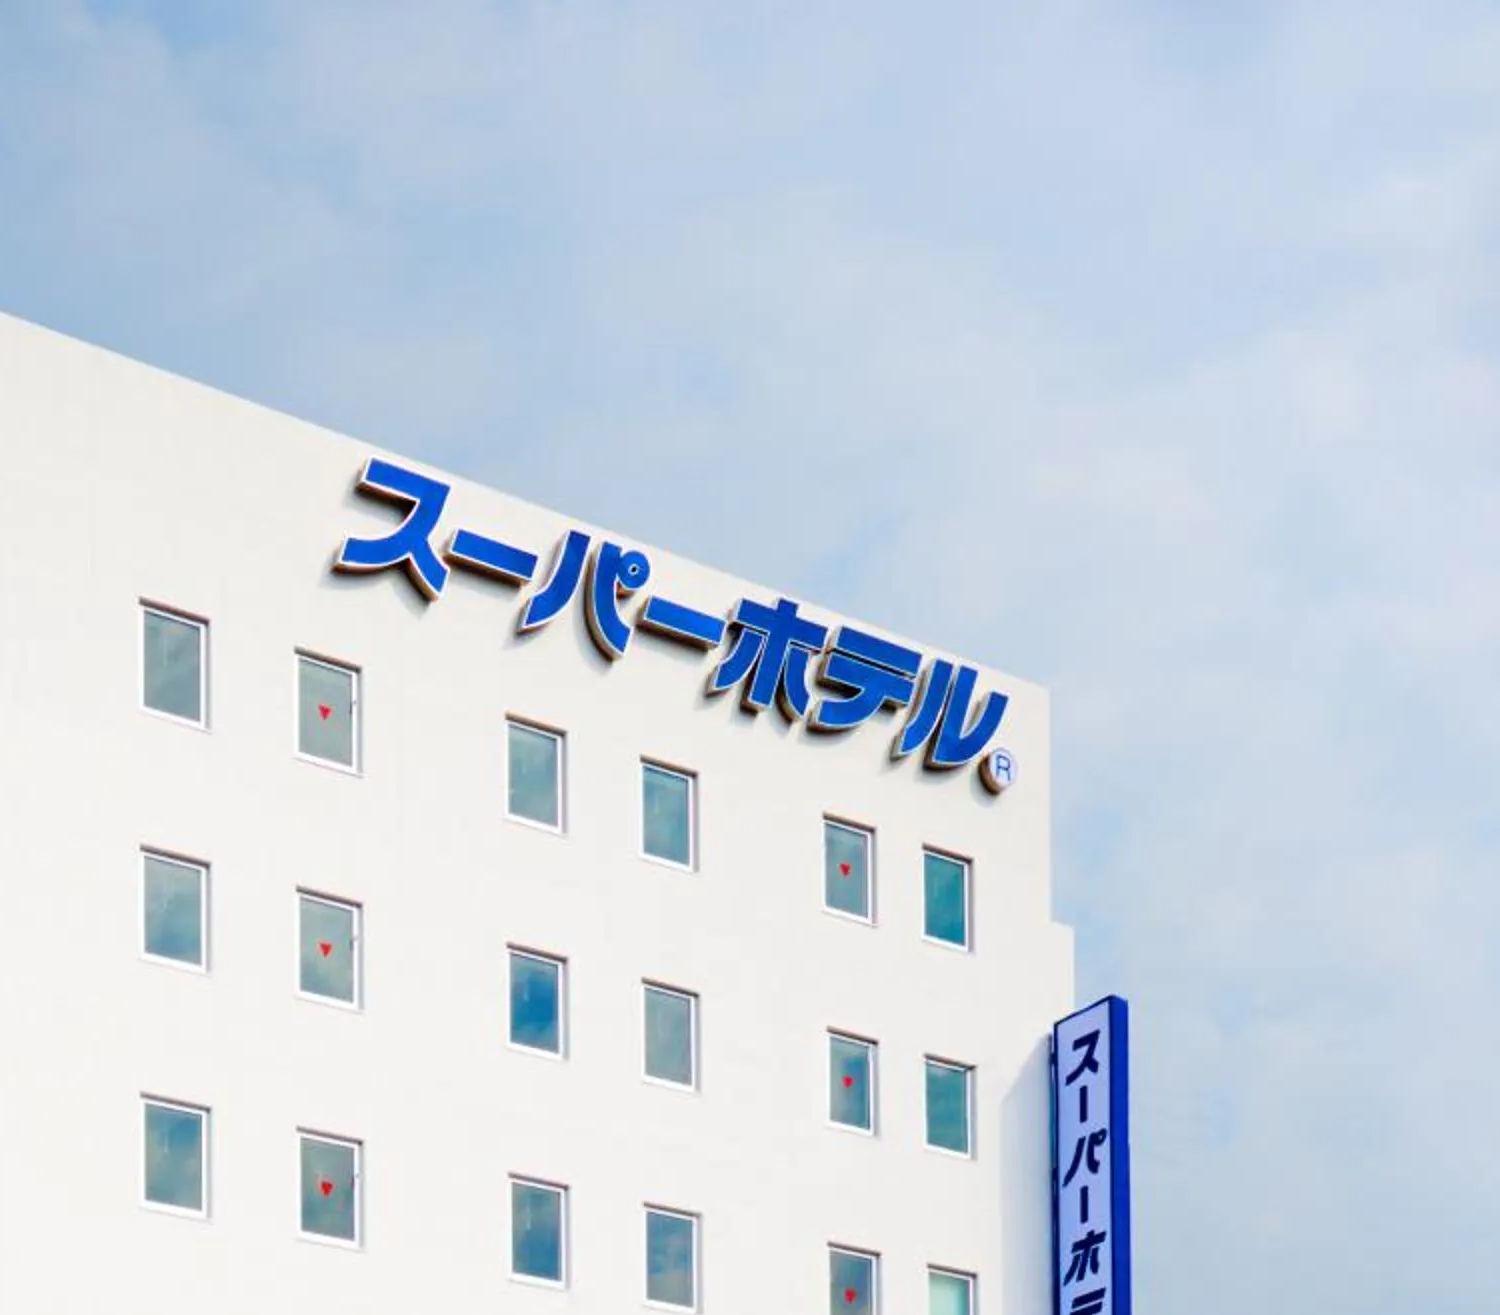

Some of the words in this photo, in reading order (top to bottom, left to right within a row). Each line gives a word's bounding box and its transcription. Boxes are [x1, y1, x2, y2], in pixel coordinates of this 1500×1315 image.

[332, 455, 1010, 768] スーパーホテル
